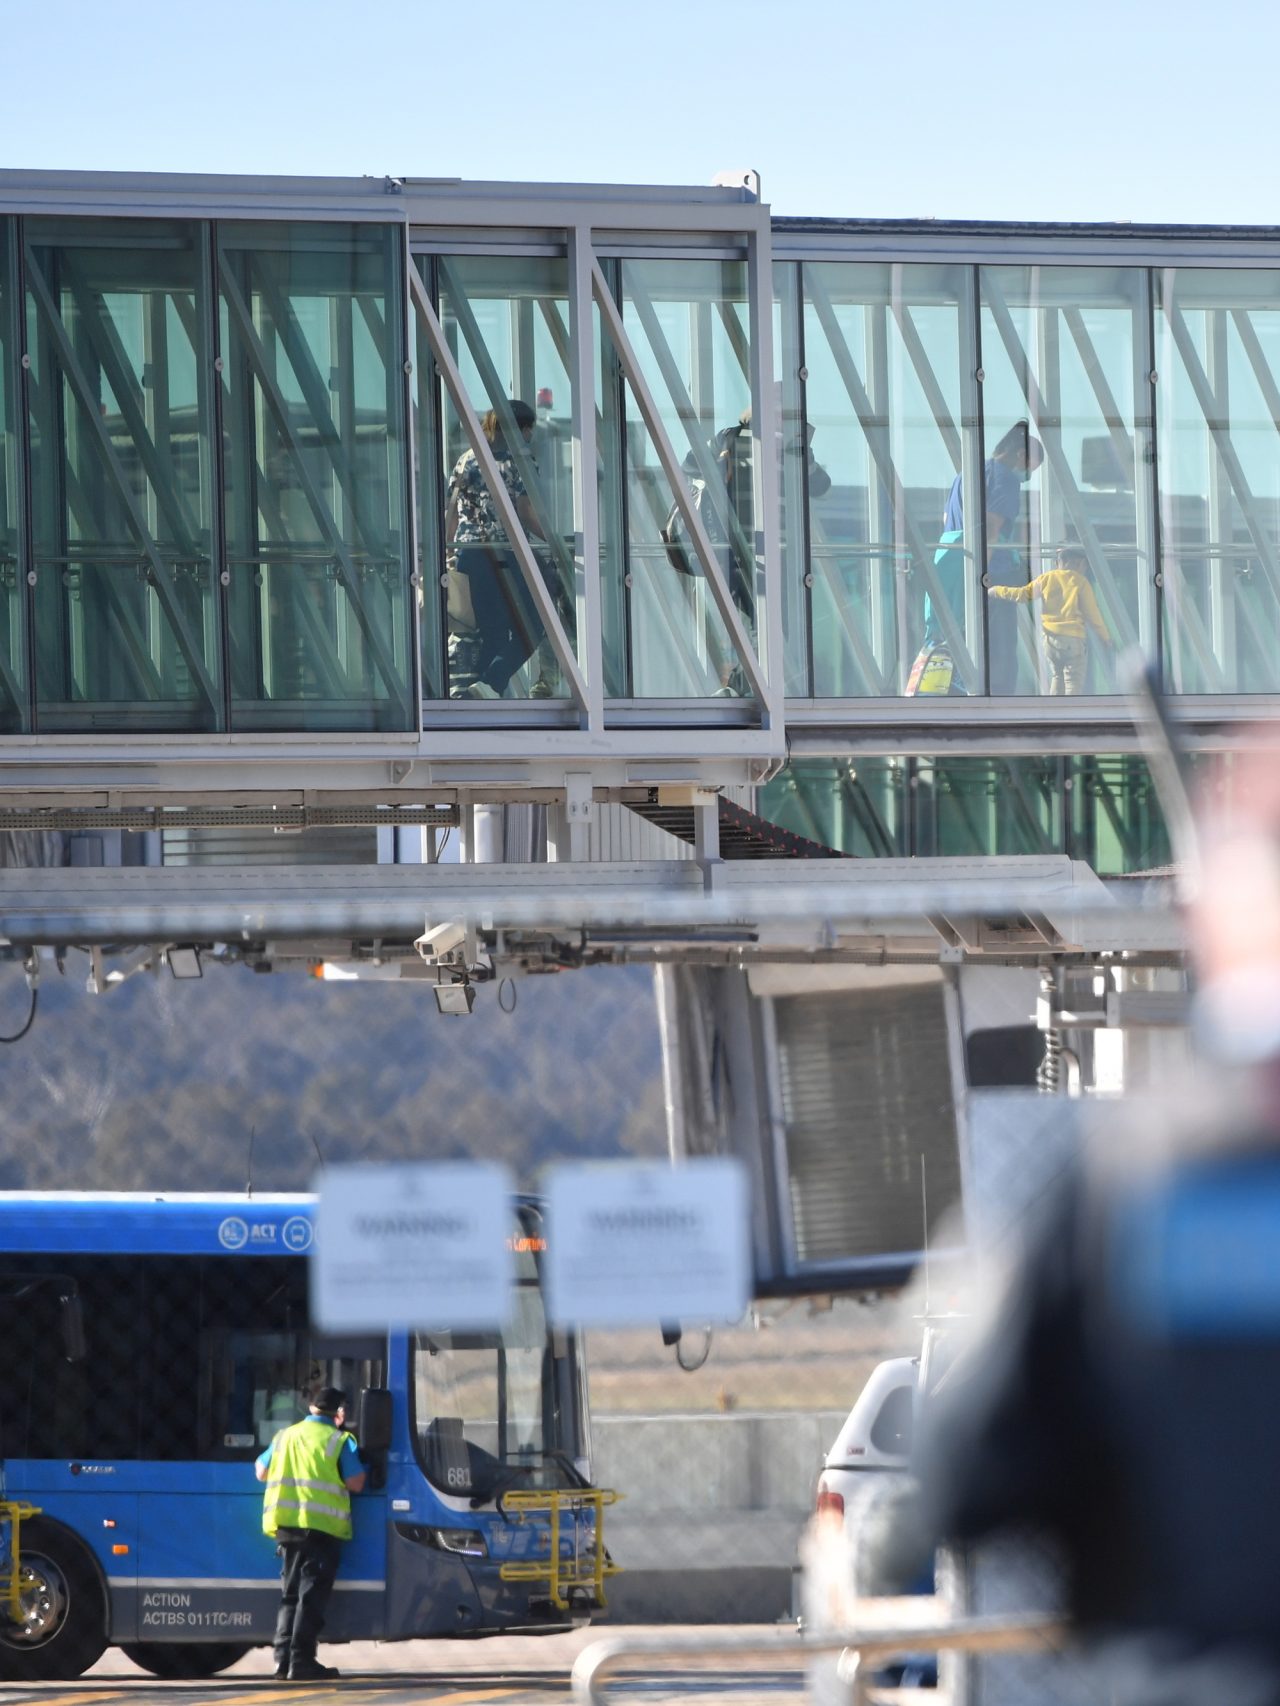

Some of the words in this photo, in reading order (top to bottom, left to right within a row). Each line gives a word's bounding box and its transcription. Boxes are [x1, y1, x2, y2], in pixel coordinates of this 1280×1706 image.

[250, 1223, 277, 1238] ACT
[447, 1467, 473, 1486] 681
[143, 1592, 191, 1607] ACTION
[143, 1612, 185, 1626] ACTBS
